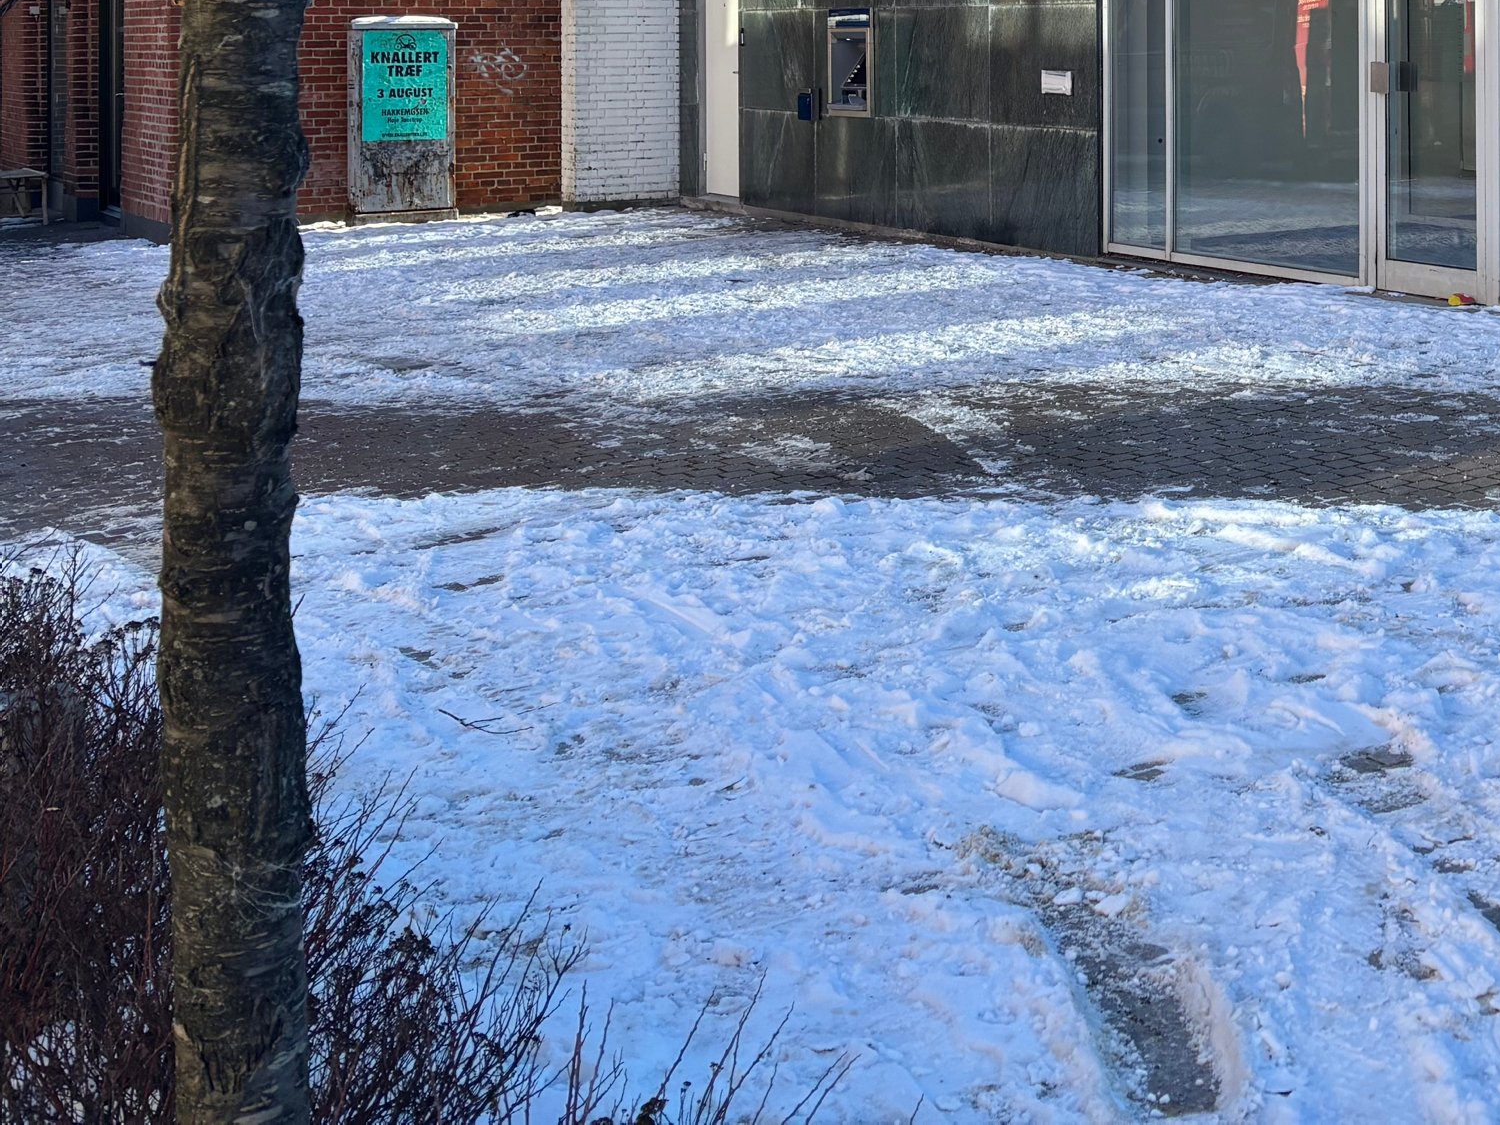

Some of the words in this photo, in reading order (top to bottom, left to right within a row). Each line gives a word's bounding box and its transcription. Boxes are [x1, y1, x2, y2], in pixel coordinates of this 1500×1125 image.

[370, 51, 440, 64] KNALLERT
[387, 64, 423, 77] TRÆF
[376, 88, 385, 99] 3
[388, 87, 433, 98] AUGUST
